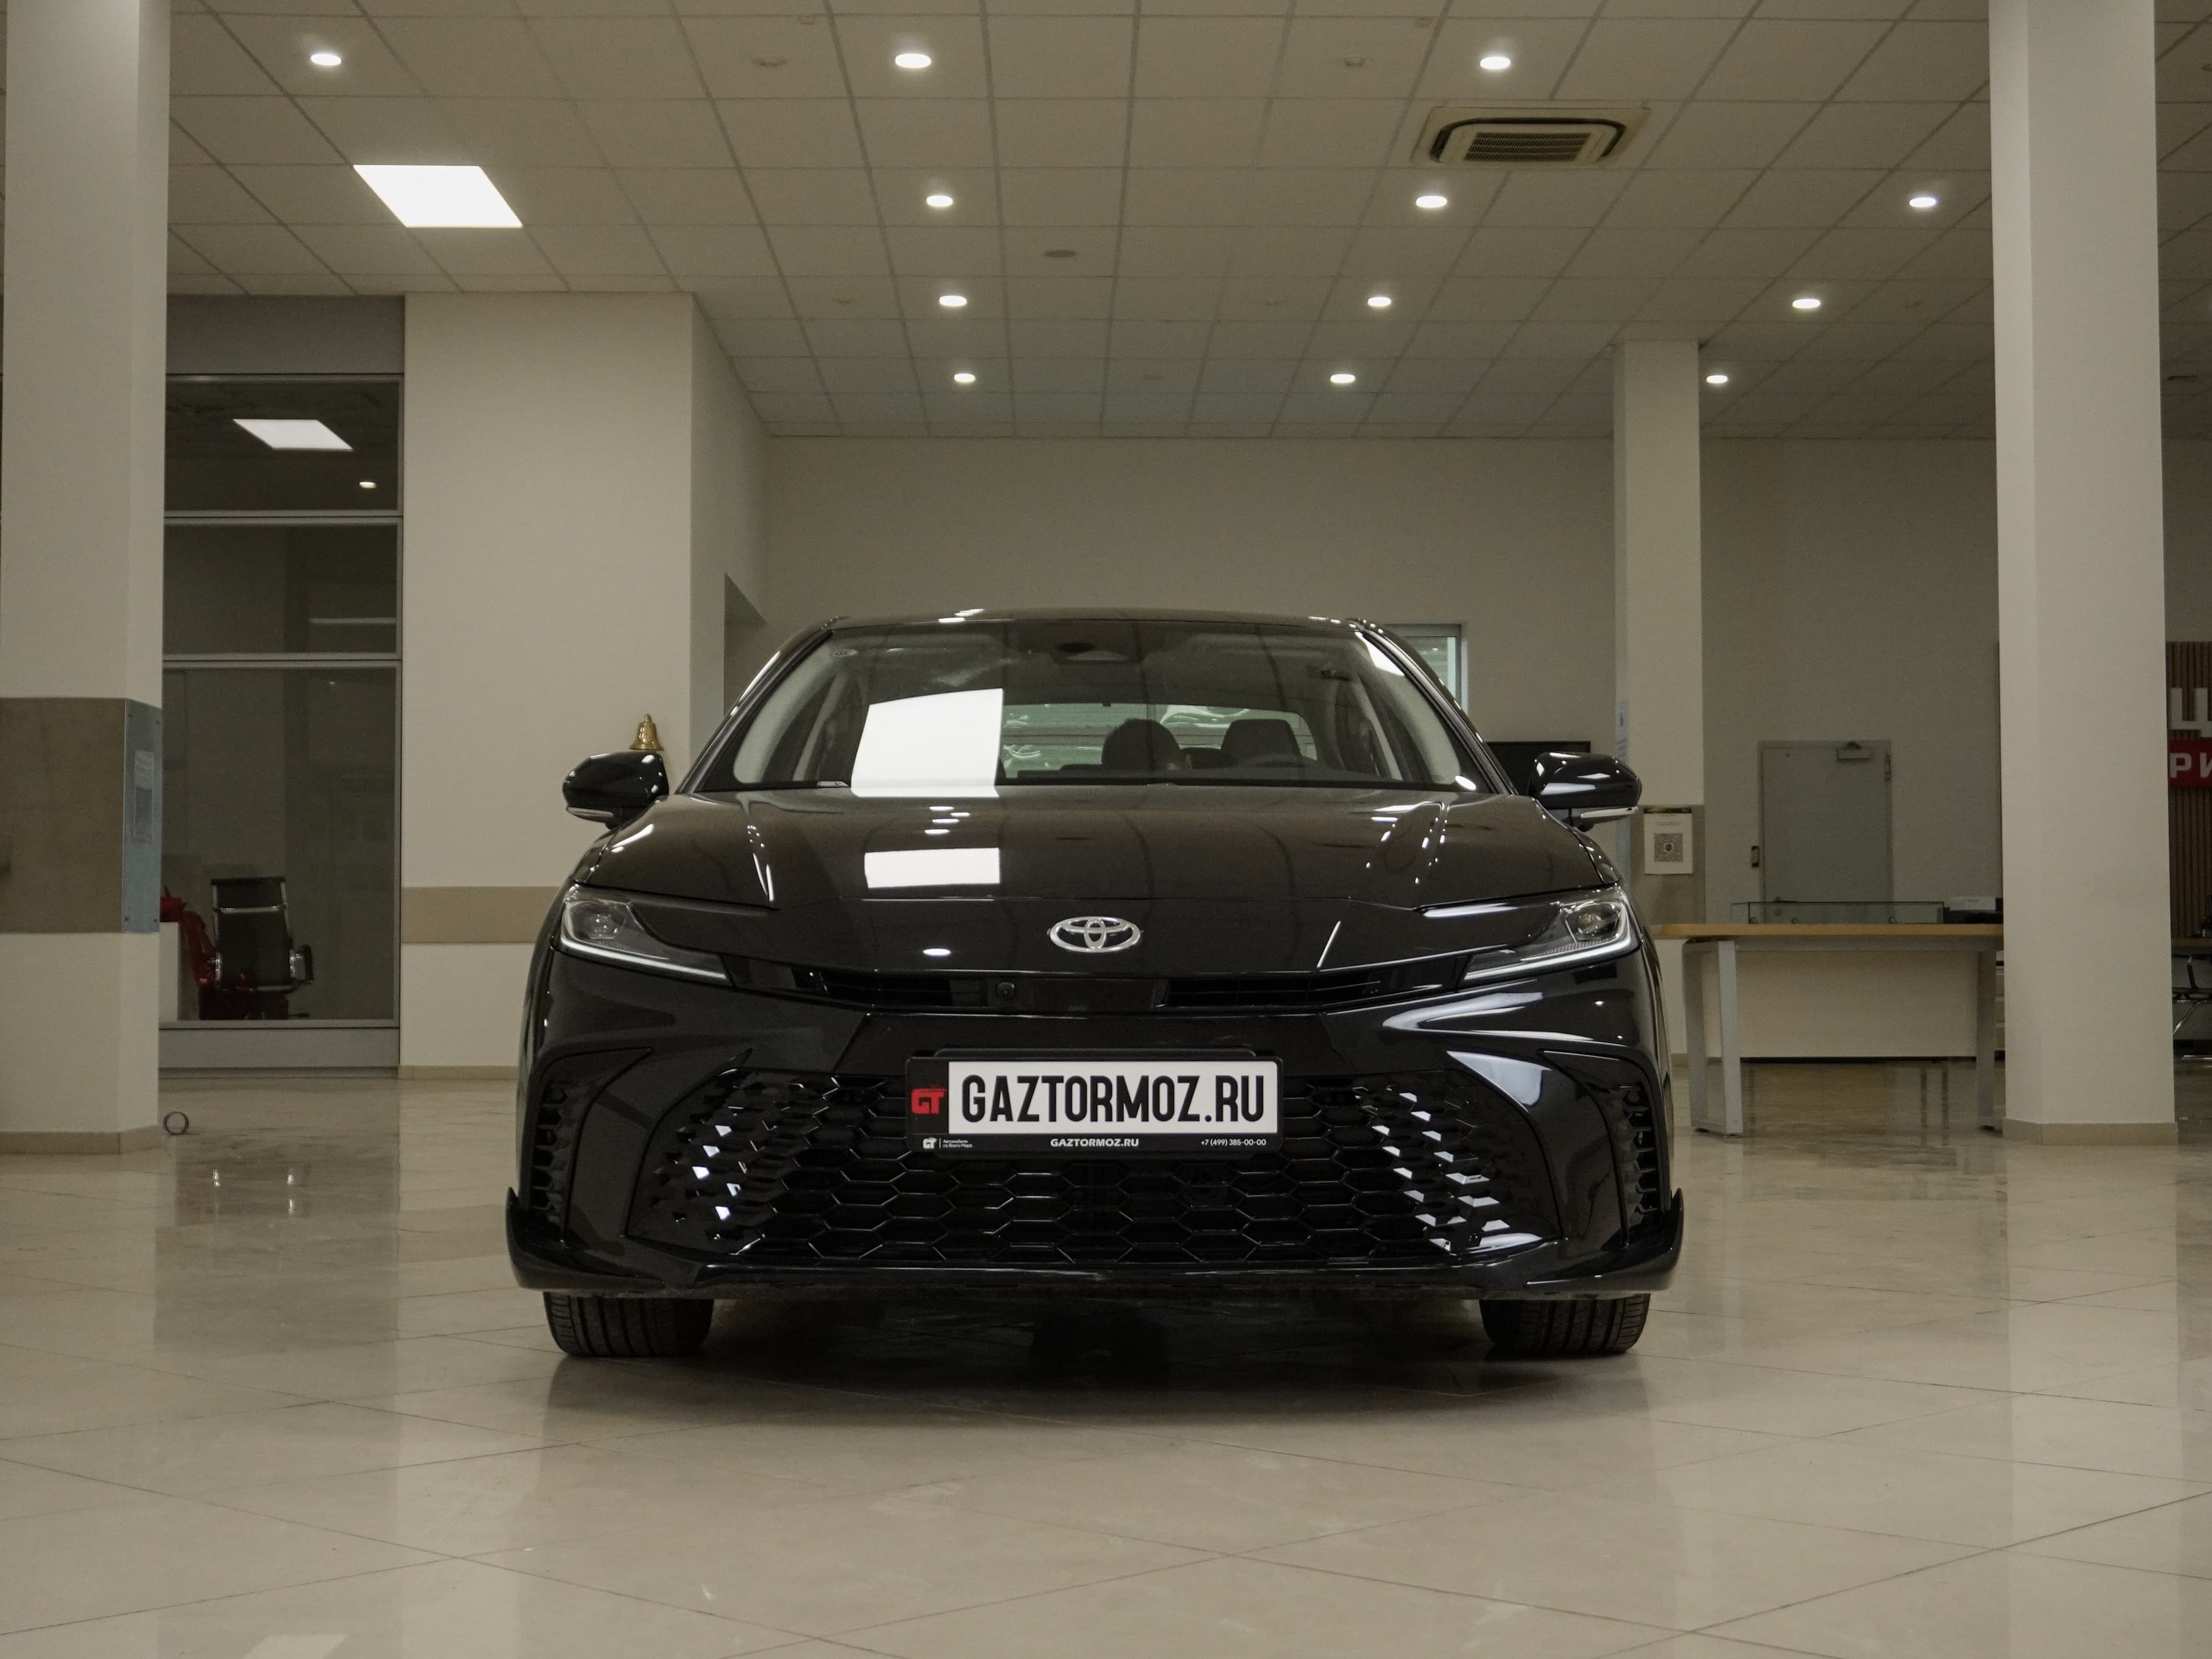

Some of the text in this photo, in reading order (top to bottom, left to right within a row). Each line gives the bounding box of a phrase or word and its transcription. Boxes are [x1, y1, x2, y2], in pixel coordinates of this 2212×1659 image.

[911, 1088, 945, 1114] GT
[962, 1075, 1264, 1122] GAZTORMOZ.RU
[923, 1137, 937, 1149] GT
